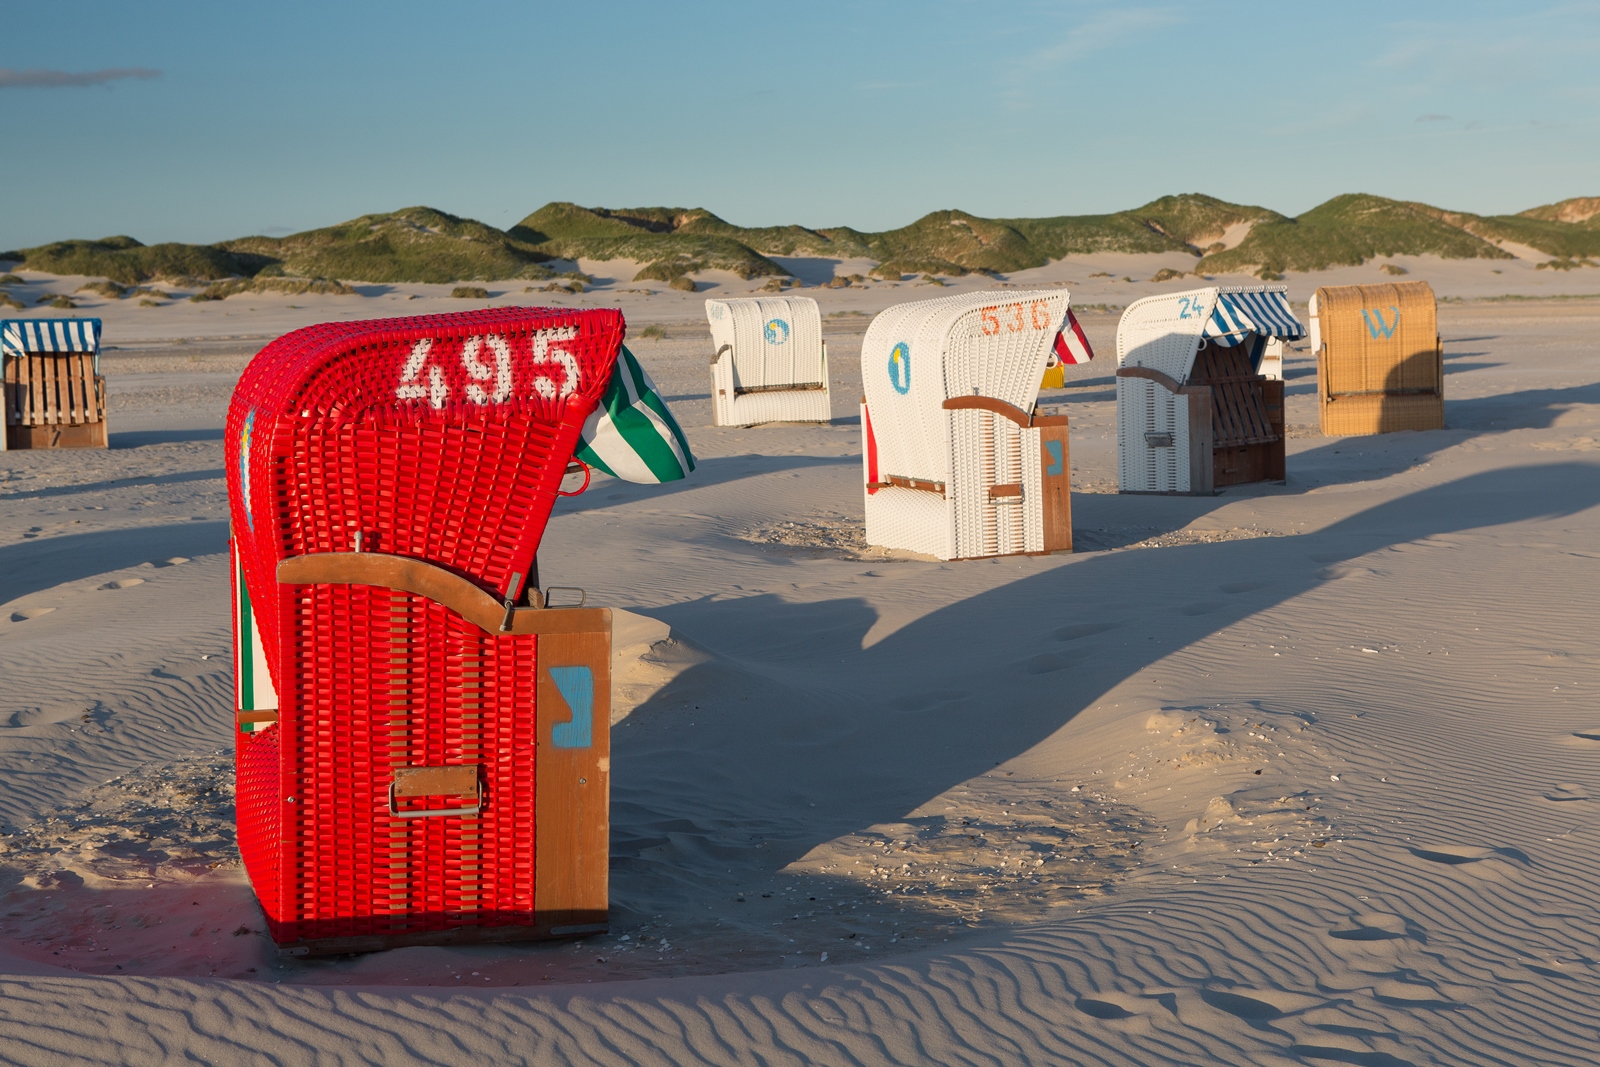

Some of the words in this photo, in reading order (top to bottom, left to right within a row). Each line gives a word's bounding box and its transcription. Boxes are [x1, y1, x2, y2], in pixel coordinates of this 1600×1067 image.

[981, 299, 1051, 336] 536
[1178, 296, 1205, 320] 24
[1360, 305, 1401, 341] W
[395, 325, 582, 410] 495
